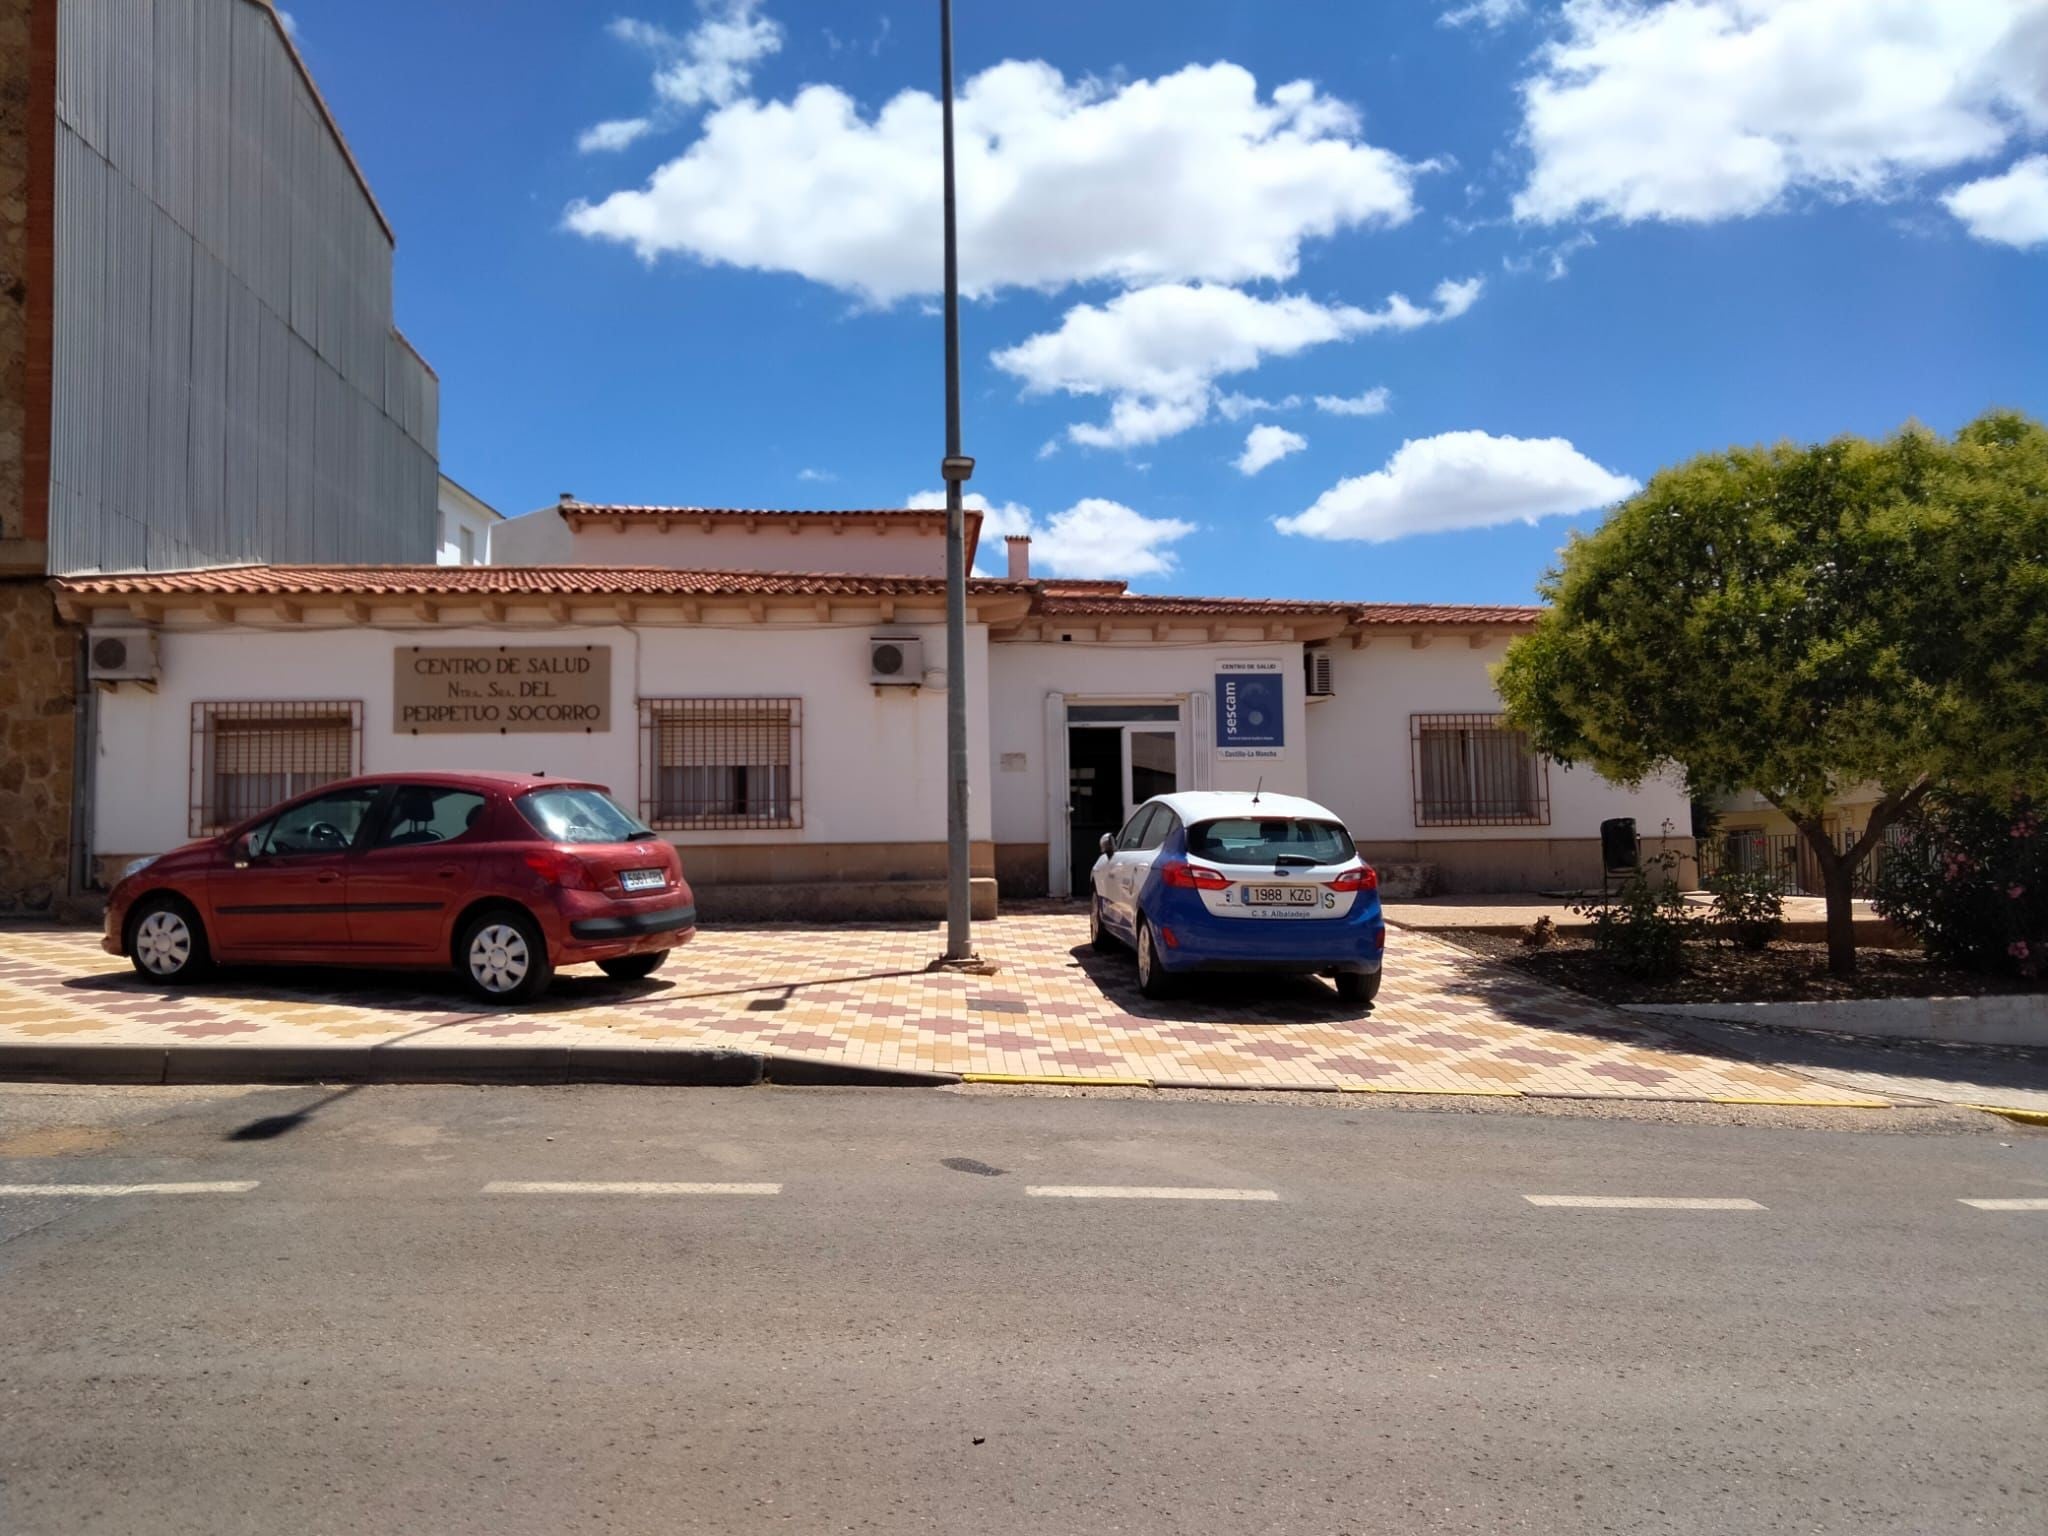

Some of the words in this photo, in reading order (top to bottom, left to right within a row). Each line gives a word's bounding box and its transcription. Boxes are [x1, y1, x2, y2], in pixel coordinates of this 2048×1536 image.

[414, 658, 491, 674] CENTRO
[496, 658, 520, 674] DE
[526, 657, 591, 674] SALUD
[519, 681, 557, 698] DEL
[403, 705, 500, 722] PERPETUO
[506, 704, 601, 721] SOCORRO
[1225, 681, 1237, 735] sescam
[1254, 888, 1282, 901] 1988
[1289, 889, 1312, 901] KZG
[1270, 910, 1311, 918] Albaladejo
